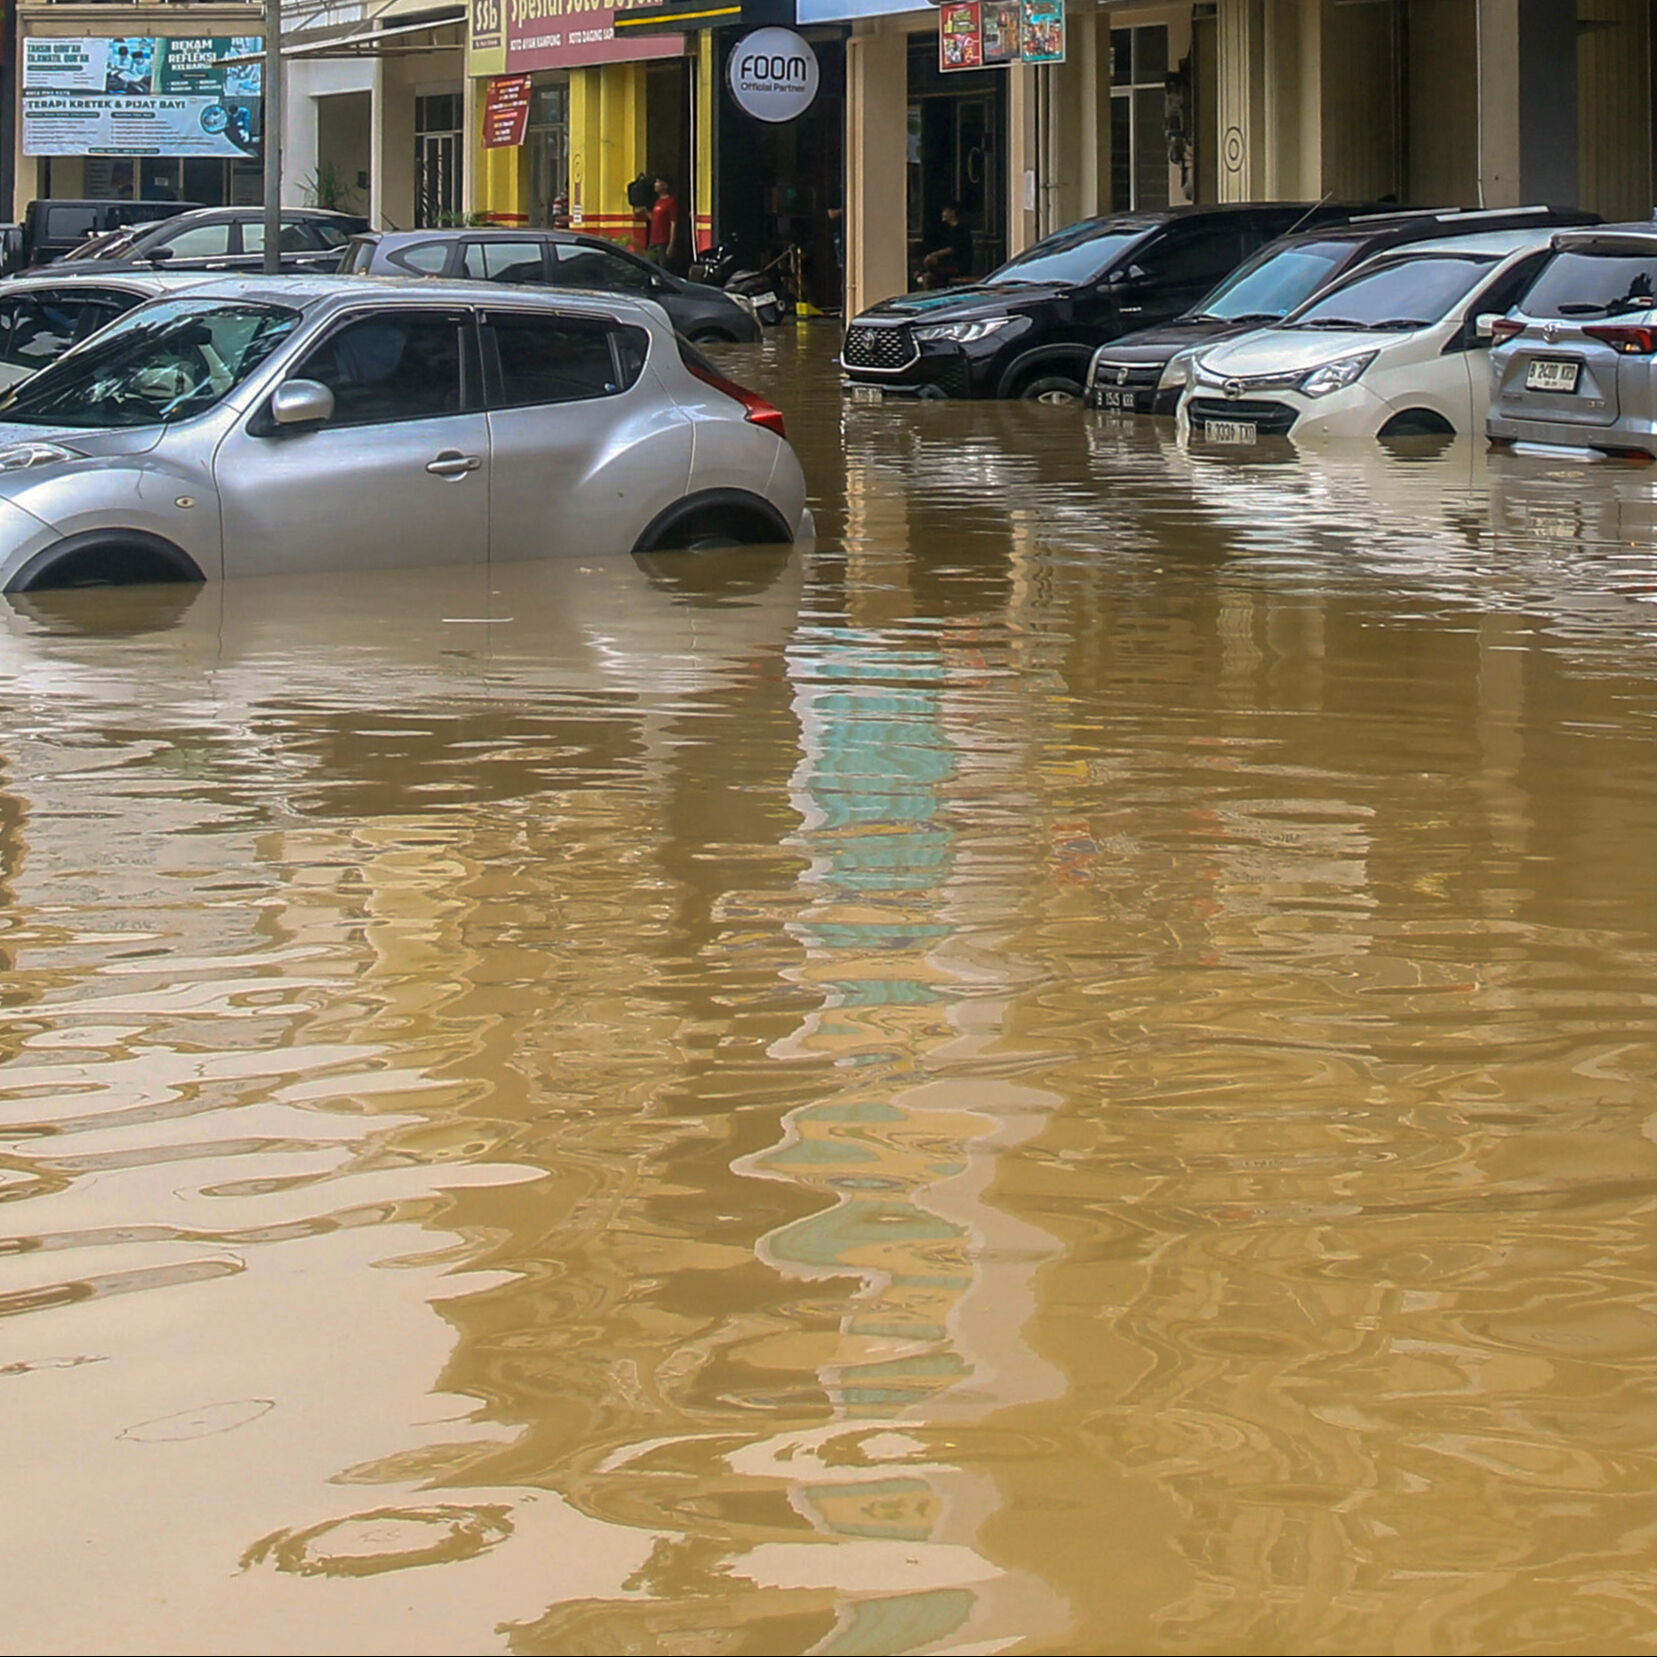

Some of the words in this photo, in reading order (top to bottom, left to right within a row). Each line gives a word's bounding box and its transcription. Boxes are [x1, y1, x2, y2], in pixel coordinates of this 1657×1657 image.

[170, 40, 213, 50] BEKAM
[740, 55, 807, 82] FOOM
[740, 82, 772, 92] Official
[773, 83, 805, 93] Partner
[27, 100, 67, 110] TERAPI
[69, 100, 112, 110] KRETEK
[114, 100, 123, 110] &
[125, 100, 157, 110] PIJAT
[159, 100, 187, 110] BAYI
